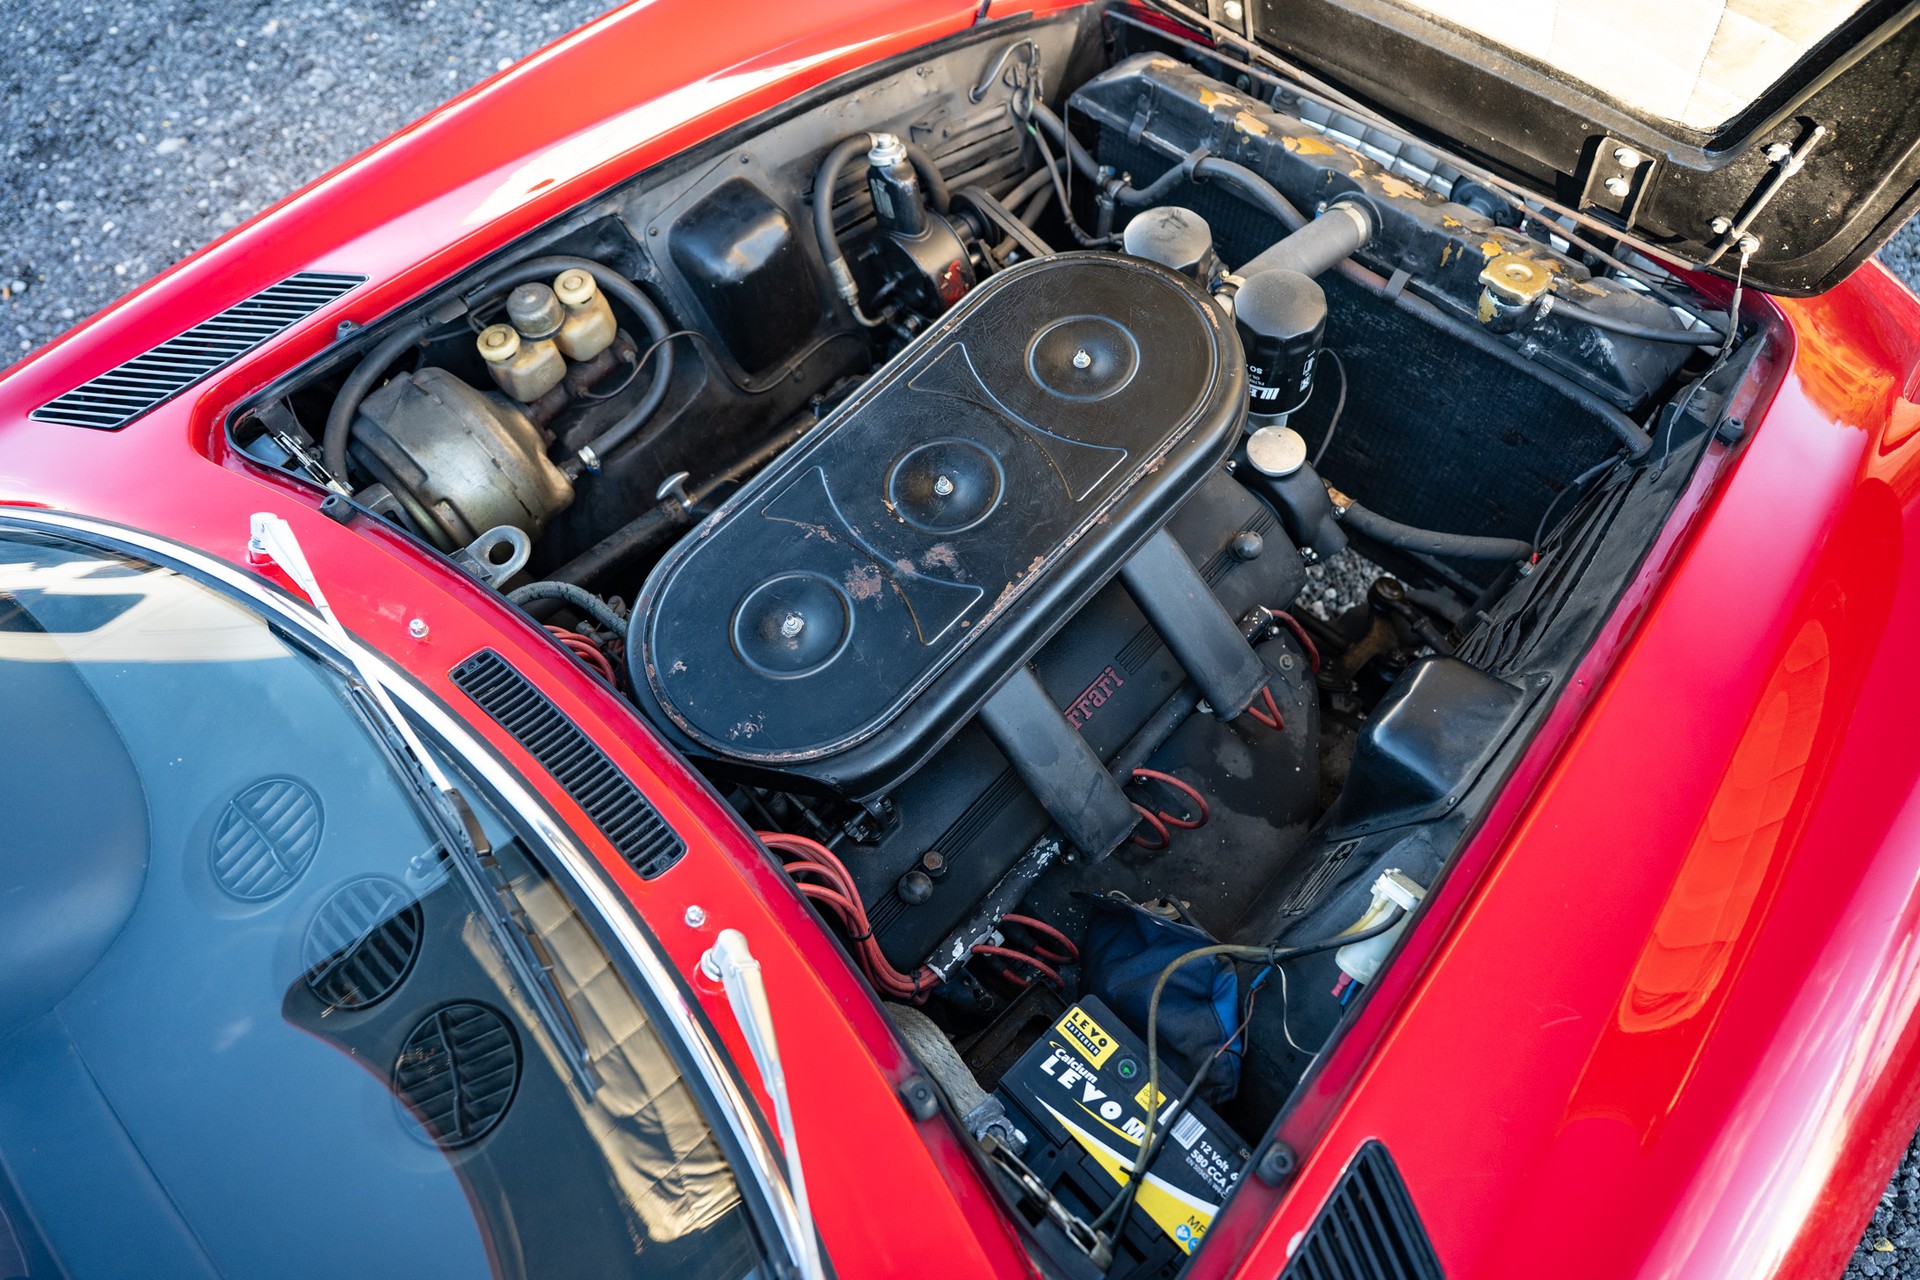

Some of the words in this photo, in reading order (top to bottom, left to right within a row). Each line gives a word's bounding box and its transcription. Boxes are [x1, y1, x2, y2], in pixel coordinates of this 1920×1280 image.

[1064, 666, 1124, 729] rrari
[1065, 1021, 1100, 1056] BATTERIEN
[1072, 1012, 1108, 1047] LEVO
[1055, 1048, 1098, 1084] Calcium
[1040, 1054, 1123, 1120] LEVO
[1121, 1116, 1147, 1144] M
[1190, 1149, 1209, 1168] 580
[1207, 1166, 1226, 1187] CCA
[1200, 1140, 1212, 1155] 12
[1211, 1151, 1230, 1172] Volt
